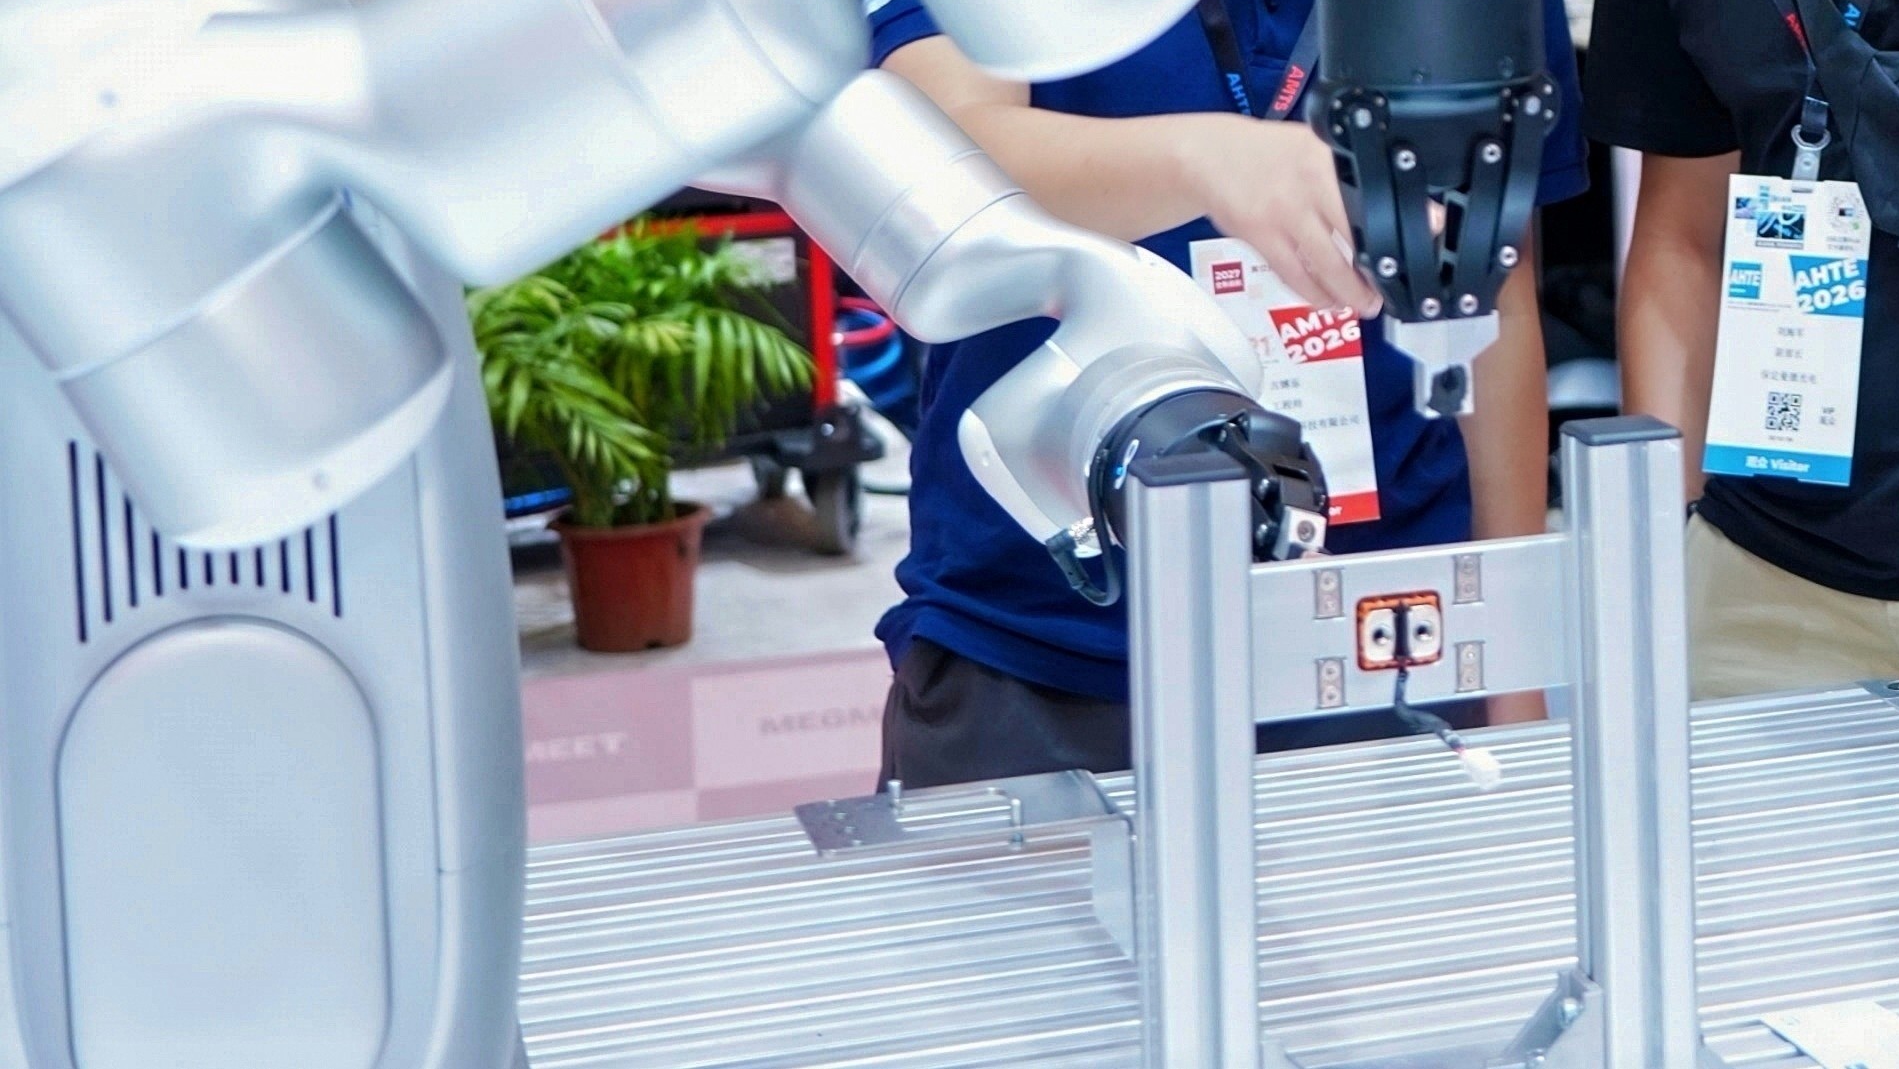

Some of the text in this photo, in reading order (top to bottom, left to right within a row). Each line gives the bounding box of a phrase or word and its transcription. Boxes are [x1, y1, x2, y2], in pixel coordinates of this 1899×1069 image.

[1273, 65, 1306, 112] AMTS
[1795, 259, 1860, 291] AHTE
[1797, 280, 1867, 314] 2026
[1287, 320, 1361, 365] 2026
